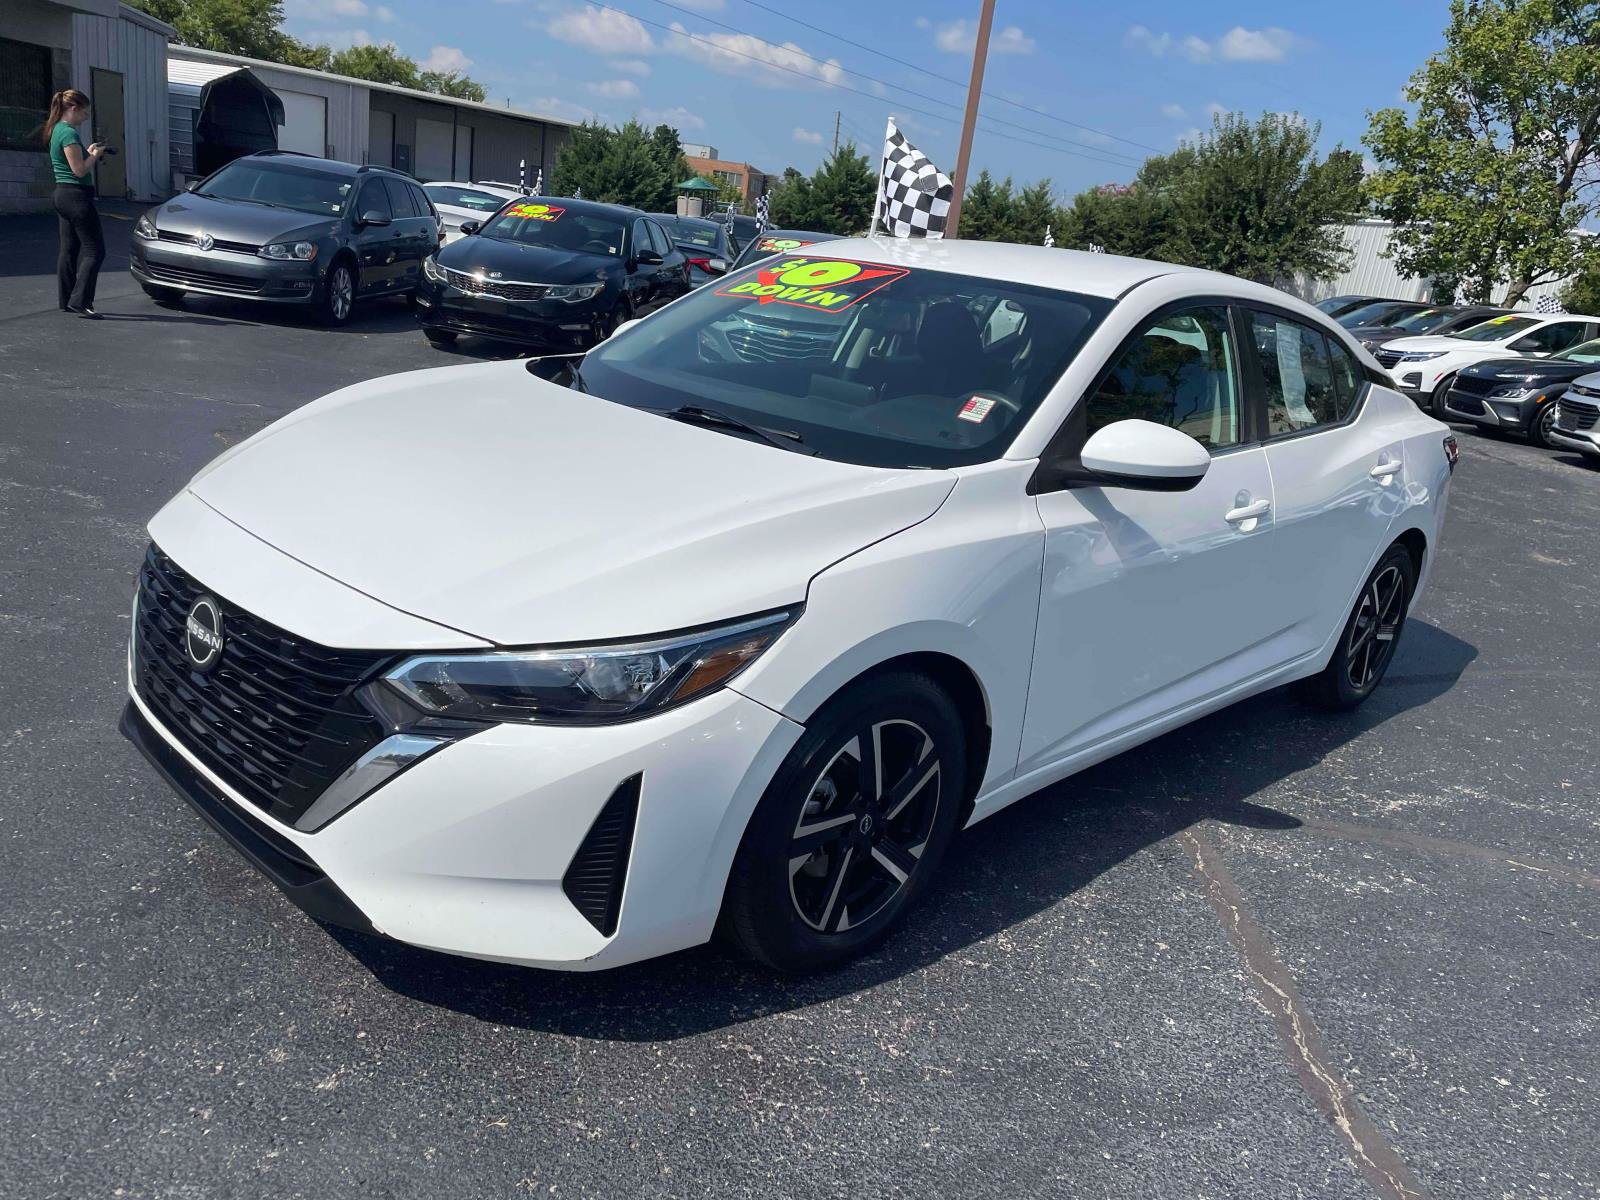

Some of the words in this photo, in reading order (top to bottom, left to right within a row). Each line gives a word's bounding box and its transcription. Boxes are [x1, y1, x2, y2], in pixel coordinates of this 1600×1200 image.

[506, 211, 555, 220] DOWN
[770, 258, 861, 286] $0
[728, 282, 851, 307] DOWN
[187, 616, 221, 649] NISSAN
